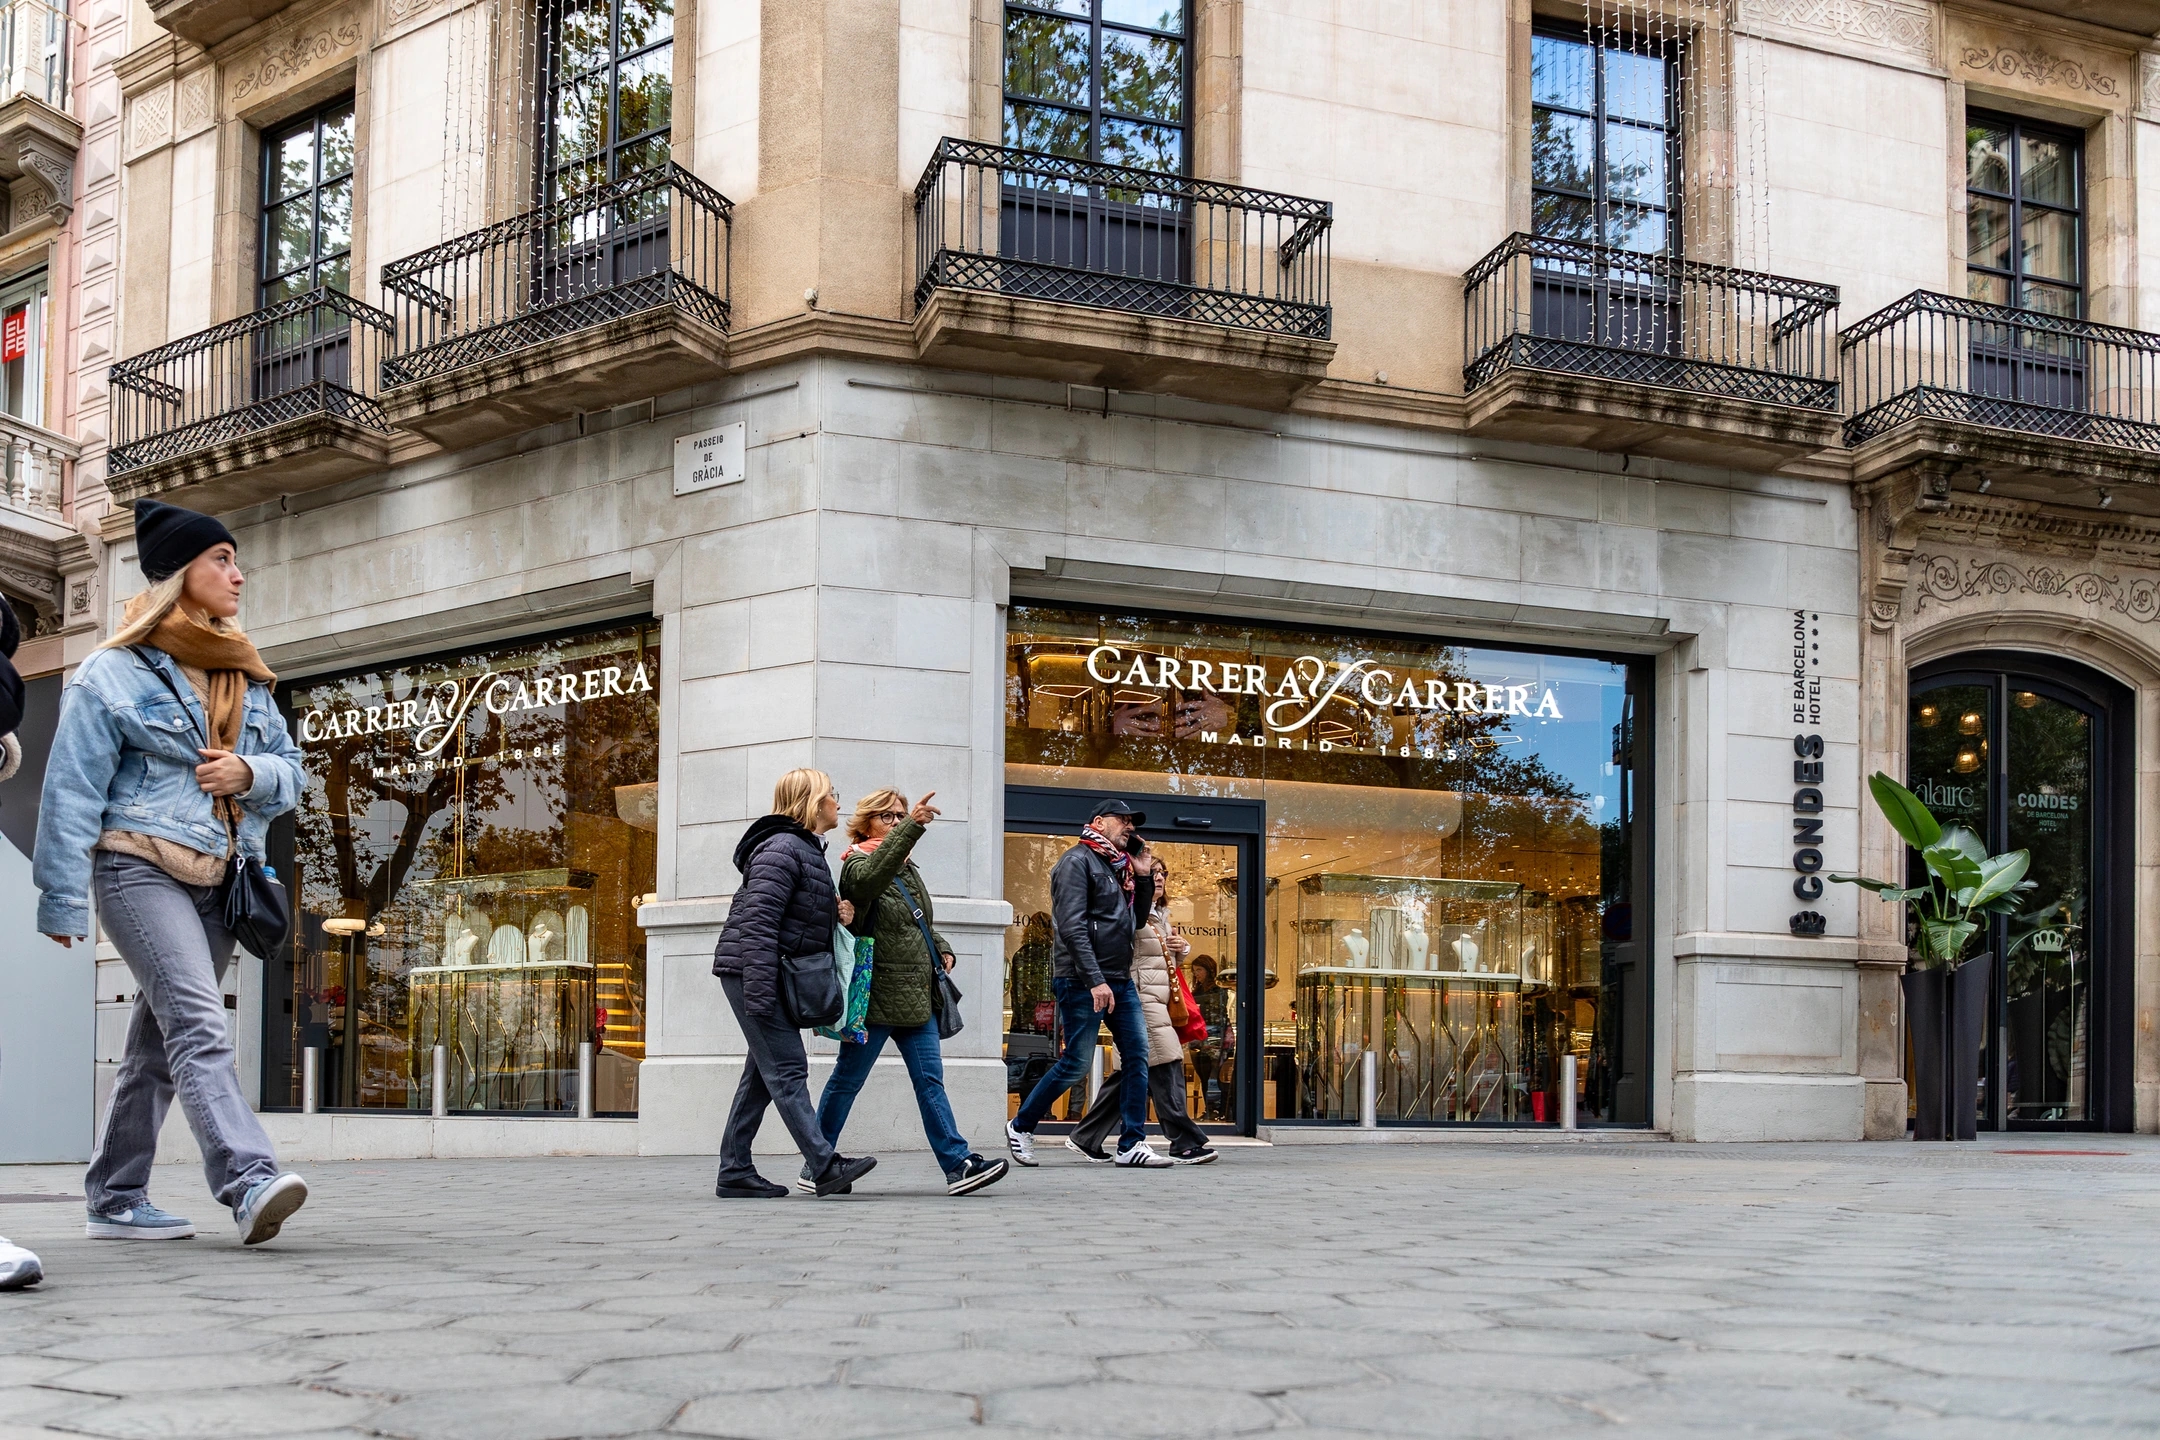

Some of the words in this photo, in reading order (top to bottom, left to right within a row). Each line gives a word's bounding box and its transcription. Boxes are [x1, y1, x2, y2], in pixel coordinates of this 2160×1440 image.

[694, 435, 723, 450] PASSEIG
[704, 452, 713, 462] DE
[693, 465, 723, 483] GRÀCIA
[1794, 609, 1806, 700] BARCELONA
[1086, 645, 1306, 699] CARRERA
[1360, 669, 1564, 719] CARRERA
[302, 694, 445, 742] CARRERA
[485, 661, 653, 714] CARRERA
[1809, 676, 1821, 725] HOTEL
[1793, 703, 1805, 724] DE
[1201, 731, 1333, 752] MADRID
[1379, 744, 1457, 761] 1885
[372, 756, 464, 779] MADRID
[499, 744, 561, 762] 1885
[2017, 793, 2078, 810] CONDES
[1793, 734, 1825, 901] CONDES
[2036, 811, 2069, 819] BARCELONA
[1171, 922, 1228, 937] iversari
